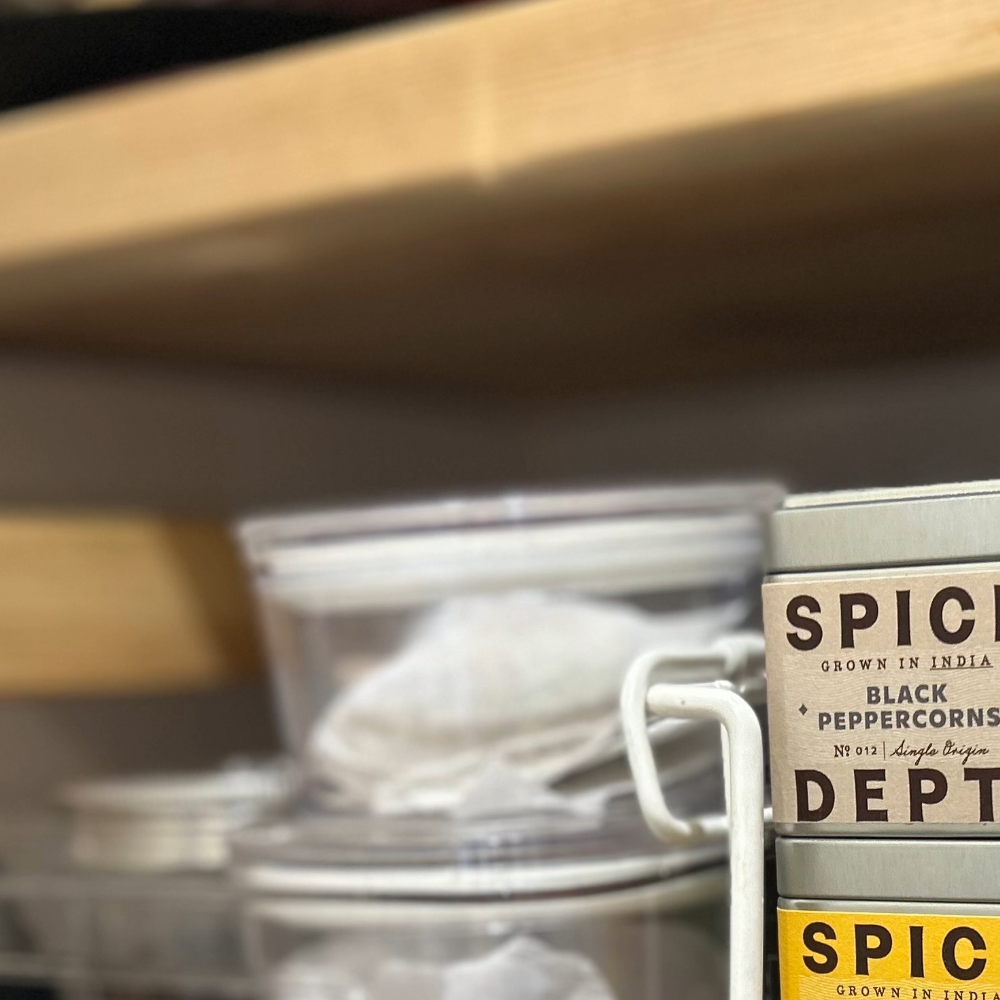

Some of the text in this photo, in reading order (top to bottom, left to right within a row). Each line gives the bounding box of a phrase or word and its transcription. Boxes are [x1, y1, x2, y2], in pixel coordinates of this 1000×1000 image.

[820, 654, 993, 672] GROWN IN INDIA
[866, 683, 948, 705] BLACK
[818, 707, 1000, 731] PEPPERCORNS
[856, 746, 878, 757] 012
[890, 739, 938, 766] Single
[942, 739, 990, 765] Origin
[836, 984, 901, 998] GROWN
[912, 988, 933, 1000] IN
